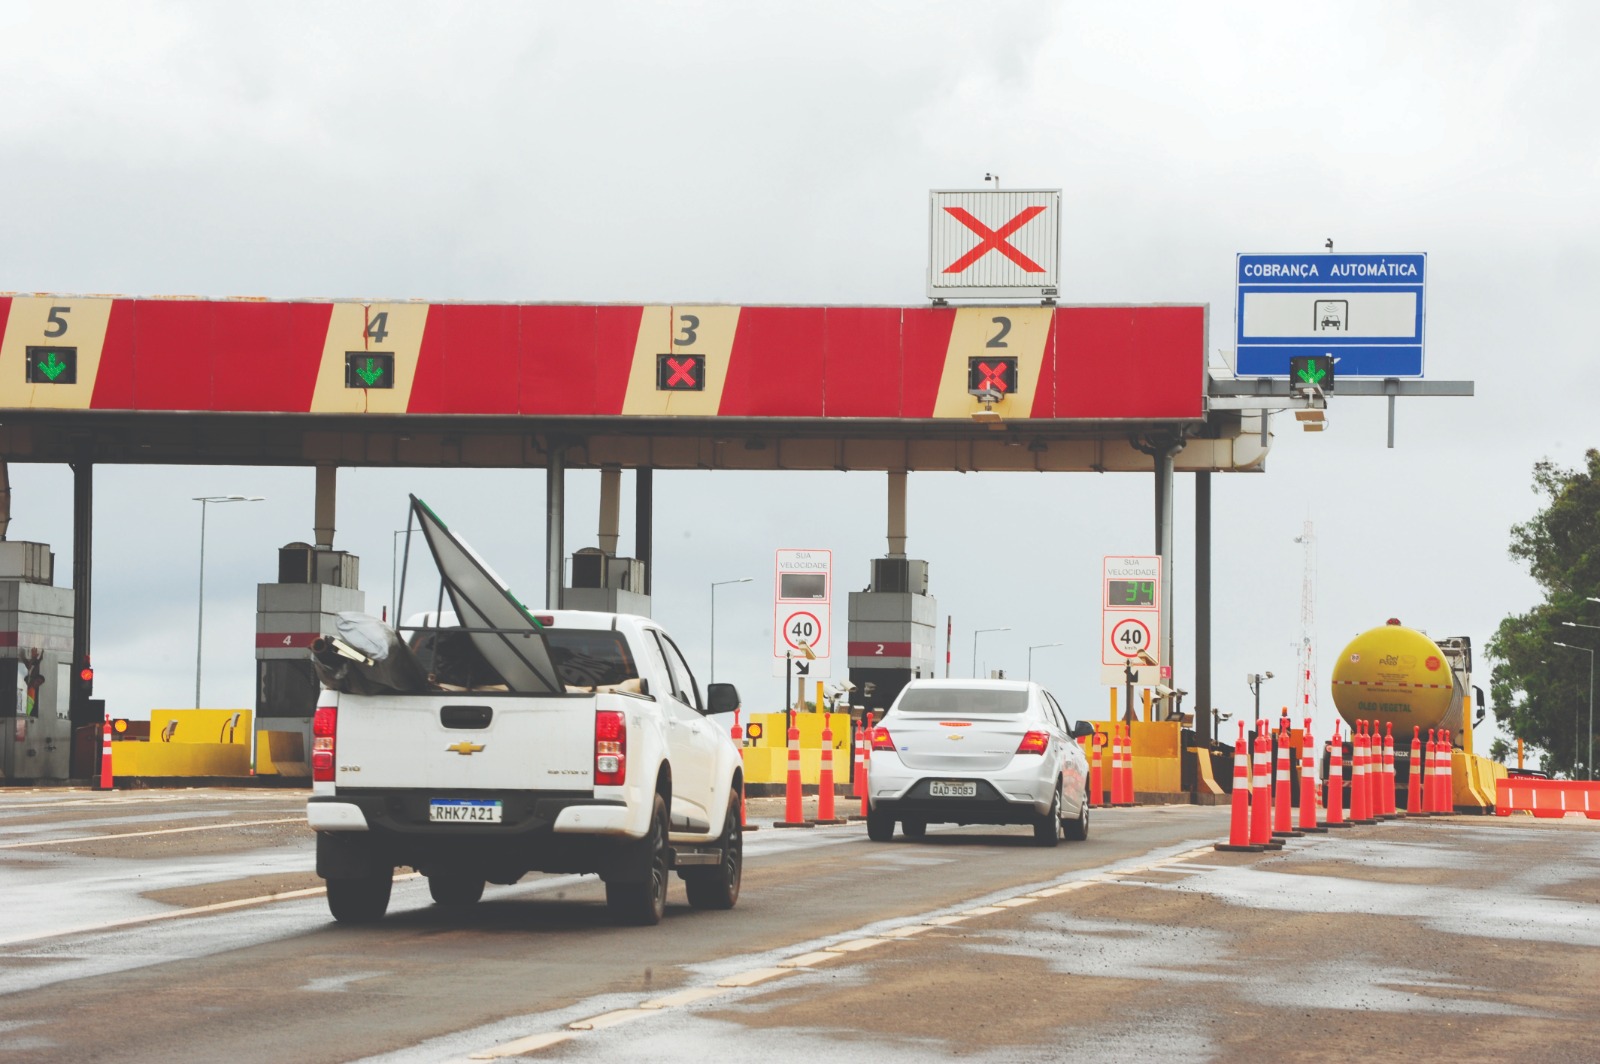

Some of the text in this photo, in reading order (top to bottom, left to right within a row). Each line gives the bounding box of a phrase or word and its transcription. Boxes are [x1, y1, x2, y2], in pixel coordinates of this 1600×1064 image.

[1244, 259, 1418, 278] COBRANÇA AUTOMÁTICA
[44, 306, 71, 338] 5
[366, 312, 388, 343] 4
[674, 315, 700, 346] 3
[985, 316, 1012, 348] 2
[1125, 581, 1154, 602] 34
[791, 622, 813, 637] 40
[1120, 629, 1142, 645] 40
[282, 635, 292, 646] 4
[875, 644, 885, 655] 2
[1379, 702, 1412, 712] VEGETAL
[436, 806, 494, 821] RHK7A21
